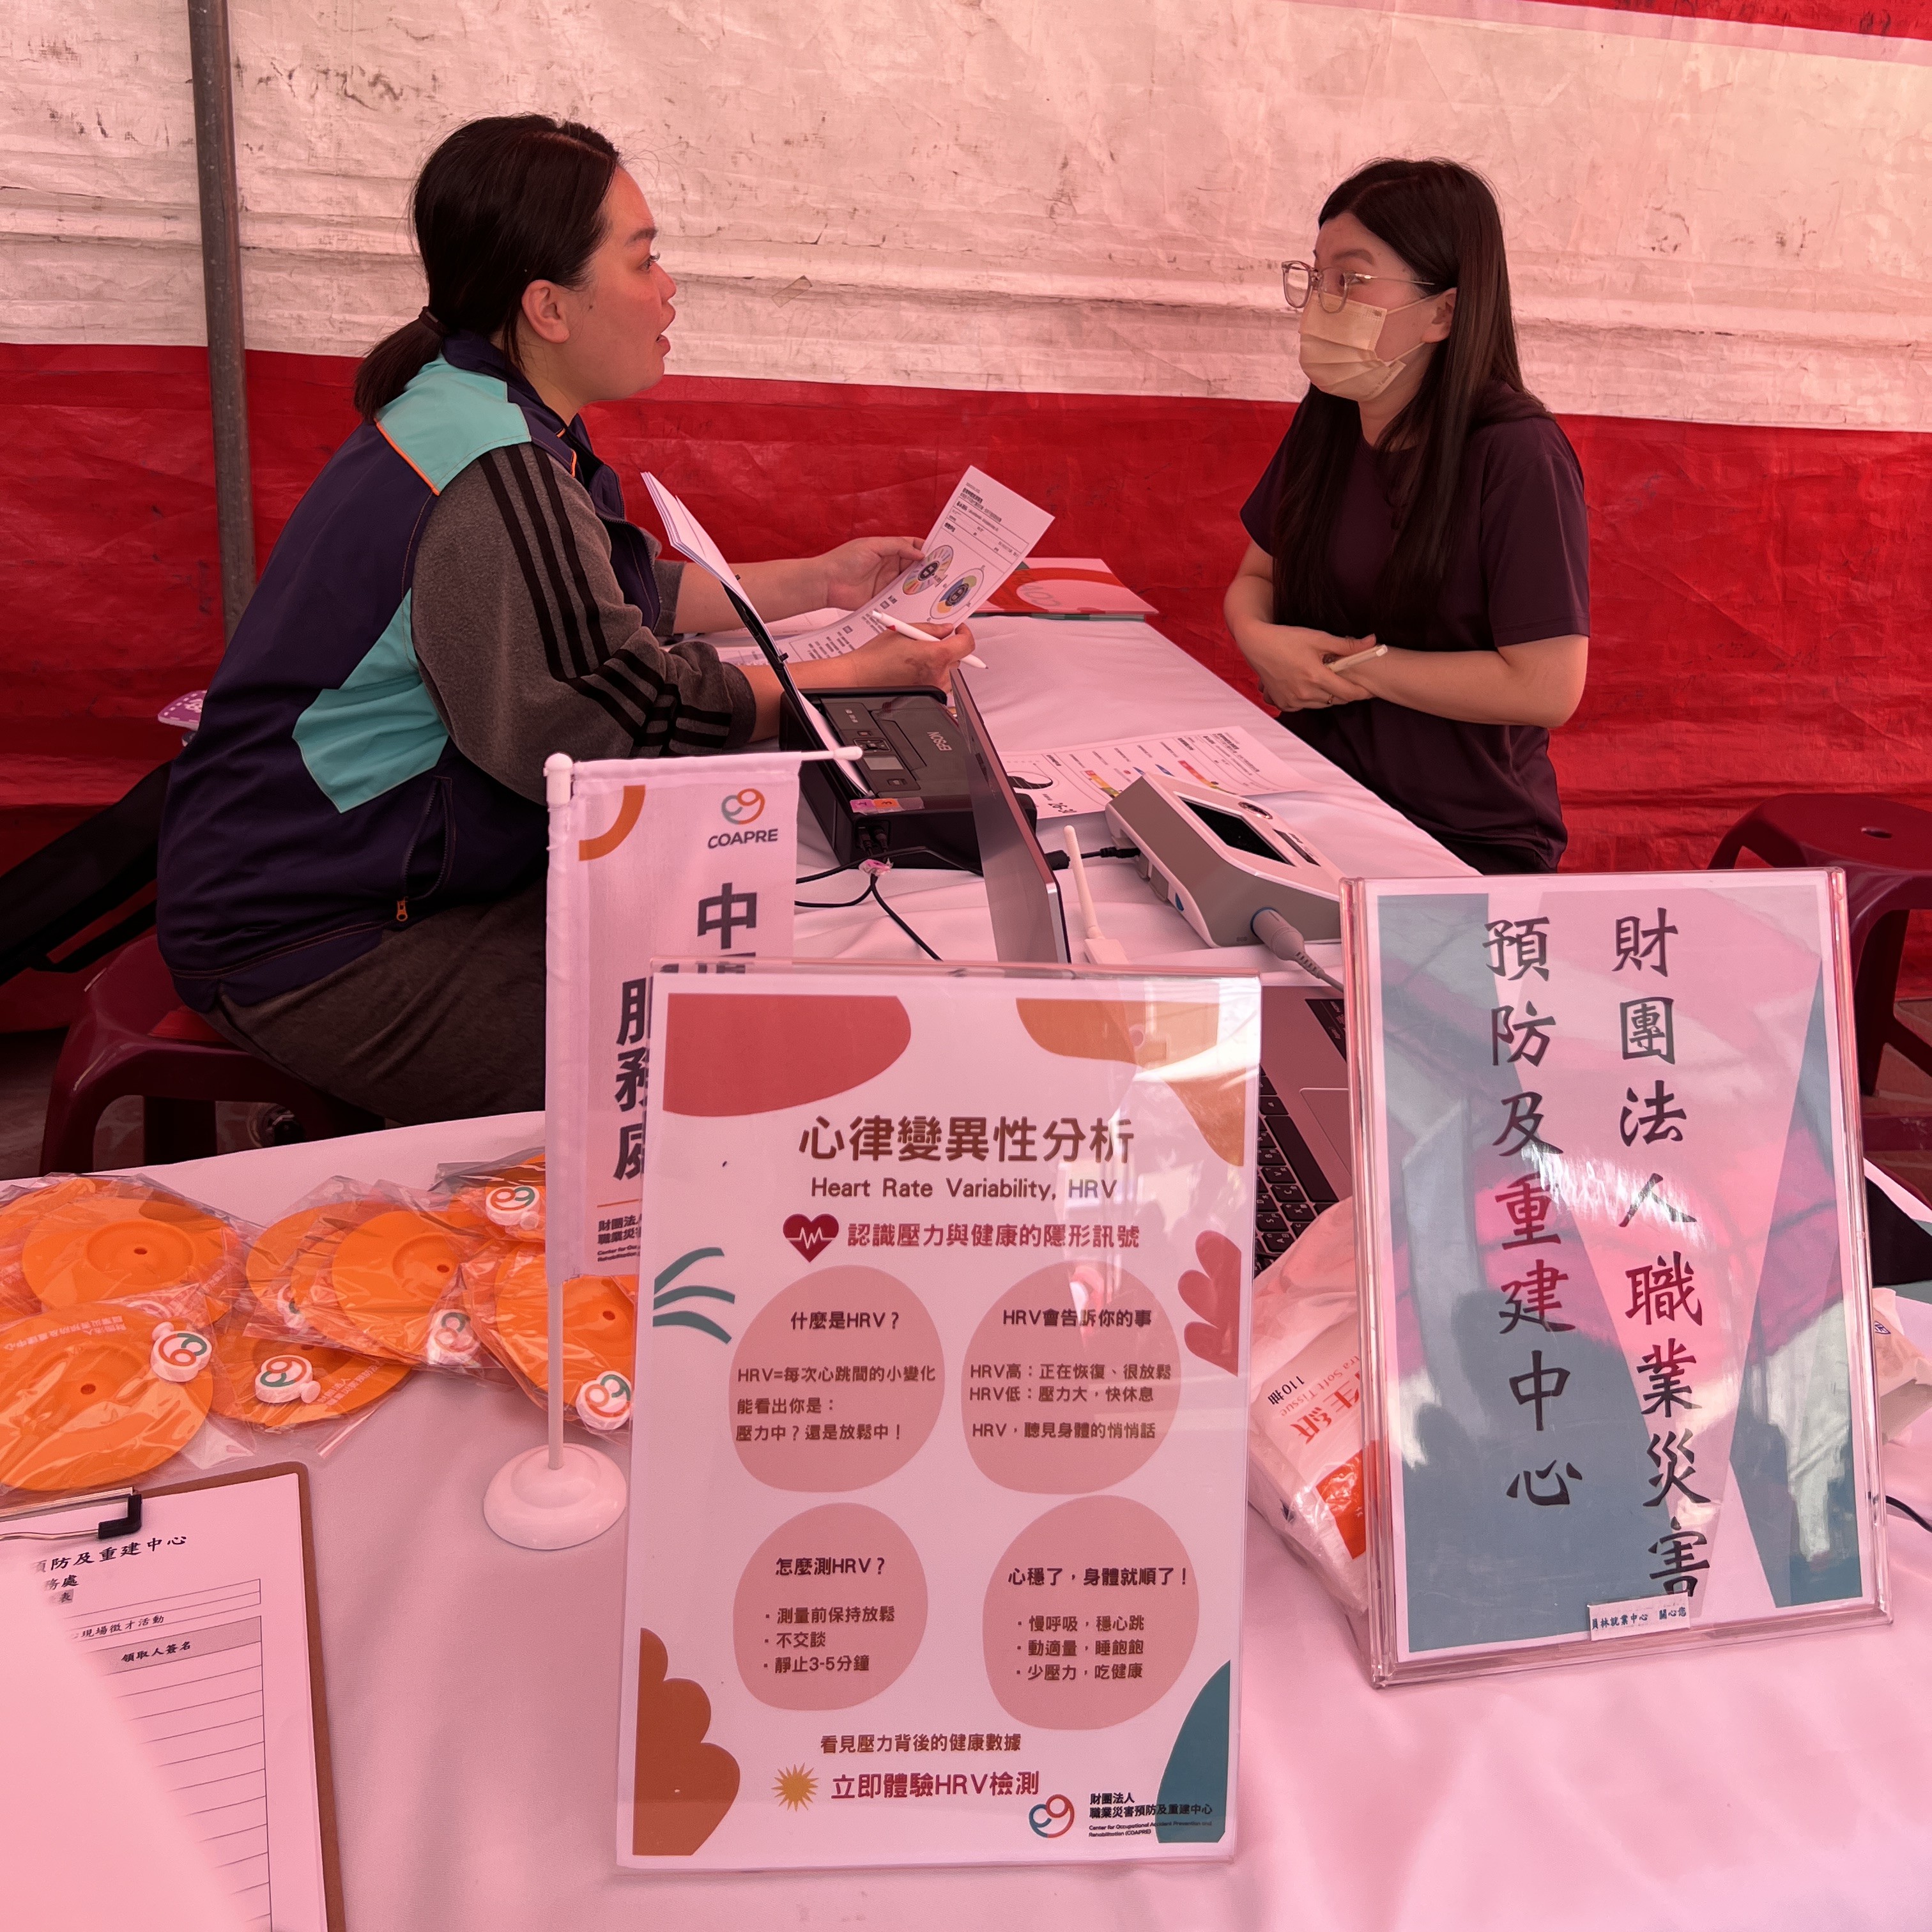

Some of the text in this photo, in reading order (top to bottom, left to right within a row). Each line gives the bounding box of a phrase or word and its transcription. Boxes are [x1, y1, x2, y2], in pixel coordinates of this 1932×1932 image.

[926, 732, 953, 751] EPSON
[707, 829, 779, 849] COAPRE
[697, 882, 758, 958] 中
[799, 1115, 1135, 1163] 心律變異性分析
[811, 1177, 1117, 1201] Heart Rate Variability, HRV
[1482, 916, 1583, 1506] 預防及重建中心
[847, 1223, 1140, 1248] 認識壓力與健康的隱形訊號
[1611, 907, 1712, 1598] 財團法人職業災害
[790, 1311, 900, 1330] 什麼是HRV？
[1002, 1309, 1152, 1328] HRV會告訴你的事
[737, 1365, 937, 1383] HRV=每次心跳間的小變化
[970, 1363, 1172, 1381] HRV高：正在恢復、很放鬆
[969, 1386, 1154, 1403] HRV低：壓力大，快休息
[1267, 1375, 1305, 1406] 110抽
[1280, 1355, 1360, 1417] tra Soft Tissue
[737, 1397, 834, 1414] 能看出你是：
[1289, 1371, 1361, 1445] 生紙
[735, 1423, 901, 1442] 壓力中？還是放鬆中！
[972, 1422, 1156, 1439] HRV，聽見身體的悄悄話
[775, 1556, 885, 1575] 怎麼測HRV？
[1008, 1567, 1188, 1586] 心穩了，身體就順了！
[776, 1606, 895, 1624] 測量前保持放鬆
[1029, 1614, 1145, 1632] 慢呼吸，穩心跳
[1591, 1613, 1648, 1630] 員林就業中心
[776, 1631, 826, 1648] 不交談
[1027, 1638, 1144, 1657] 動適量，睡飽飽
[121, 1641, 192, 1662] 領取人簽名
[774, 1655, 870, 1674] 靜止3-5分鐘
[1027, 1662, 1143, 1681] 少壓力，吃健康
[820, 1733, 1022, 1754] 看見壓力背後的健康數據
[831, 1770, 1040, 1800] 立即體驗HRV檢測
[1089, 1792, 1135, 1805] 財團法人
[1089, 1803, 1213, 1819] 職業災害預防及重建中心
